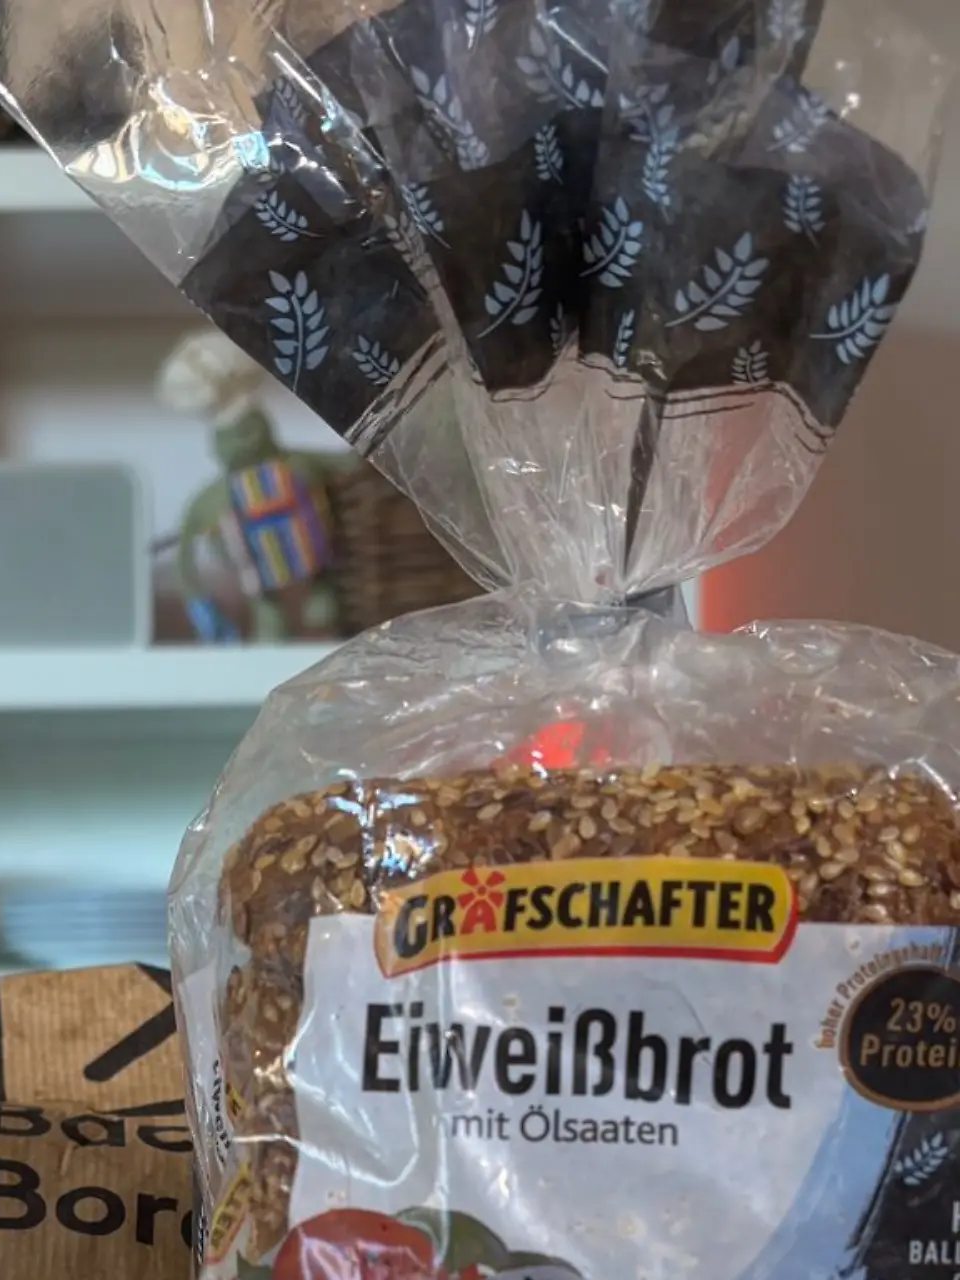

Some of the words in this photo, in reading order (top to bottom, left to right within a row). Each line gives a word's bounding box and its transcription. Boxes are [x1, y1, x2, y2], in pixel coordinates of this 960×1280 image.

[394, 870, 776, 959] GRAFSCHAFTER
[886, 997, 957, 1034] 23%
[362, 1001, 794, 1110] Eiweißbrot
[860, 1033, 960, 1069] Protei
[451, 1109, 510, 1142] mit
[520, 1105, 679, 1146] Ölsaaten
